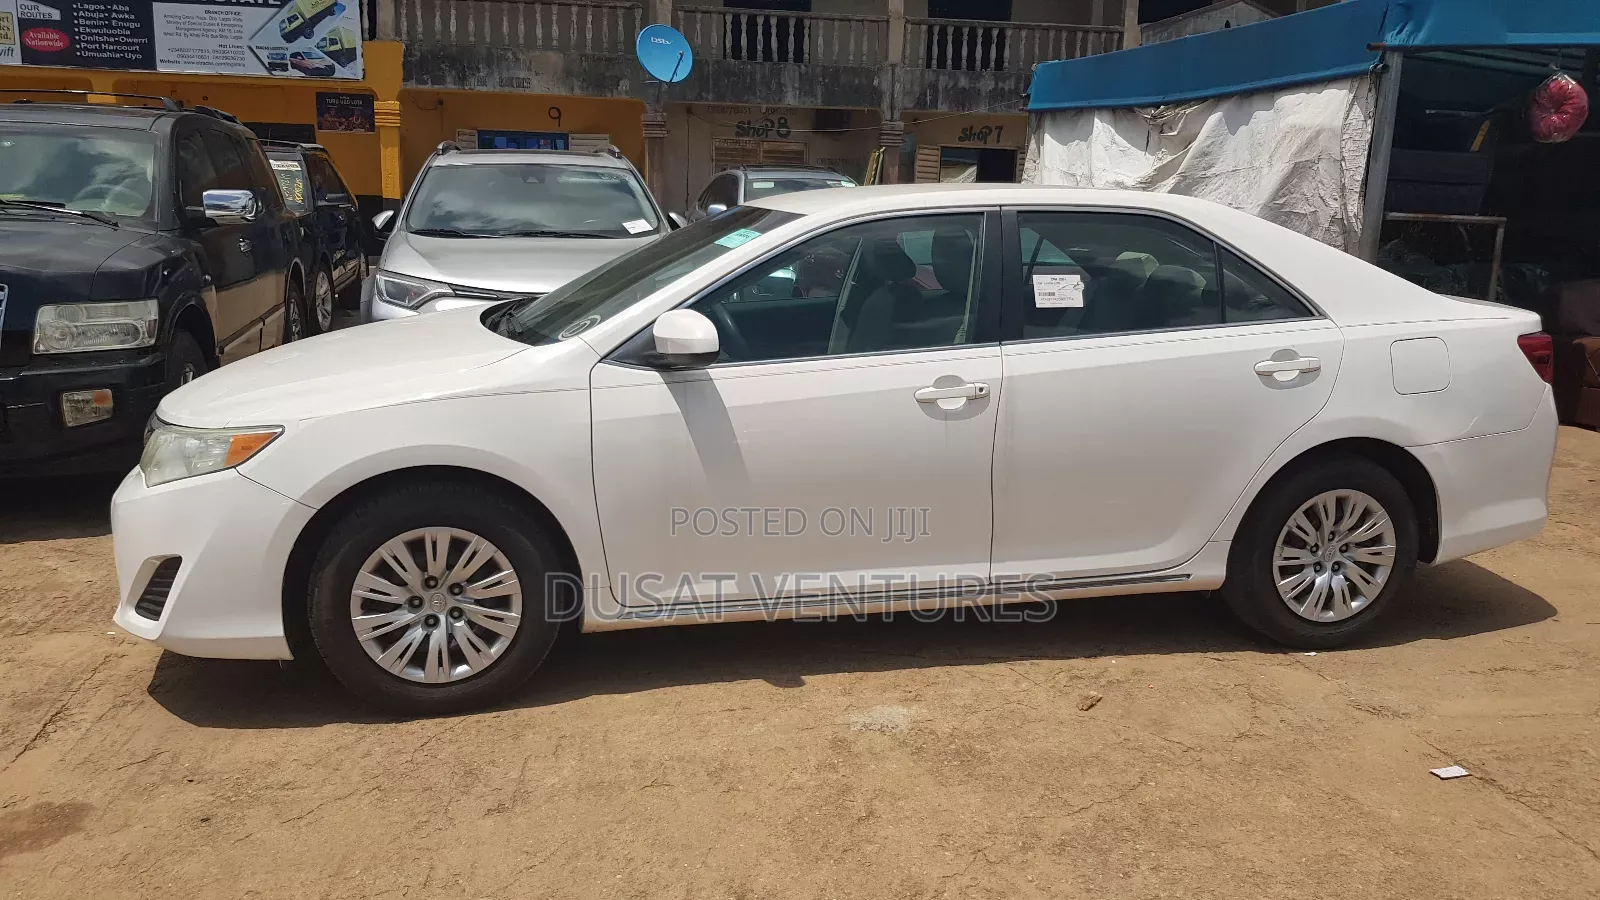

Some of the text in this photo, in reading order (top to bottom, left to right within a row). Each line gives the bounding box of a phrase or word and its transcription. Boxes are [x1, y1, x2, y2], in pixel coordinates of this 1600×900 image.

[78, 3, 105, 11] Lagos
[20, 11, 53, 19] ROUTES
[112, 20, 141, 28] Enugu
[25, 38, 64, 47] Nationwide
[125, 52, 142, 60] Uyo
[776, 116, 791, 138] 8
[994, 126, 1004, 144] 7
